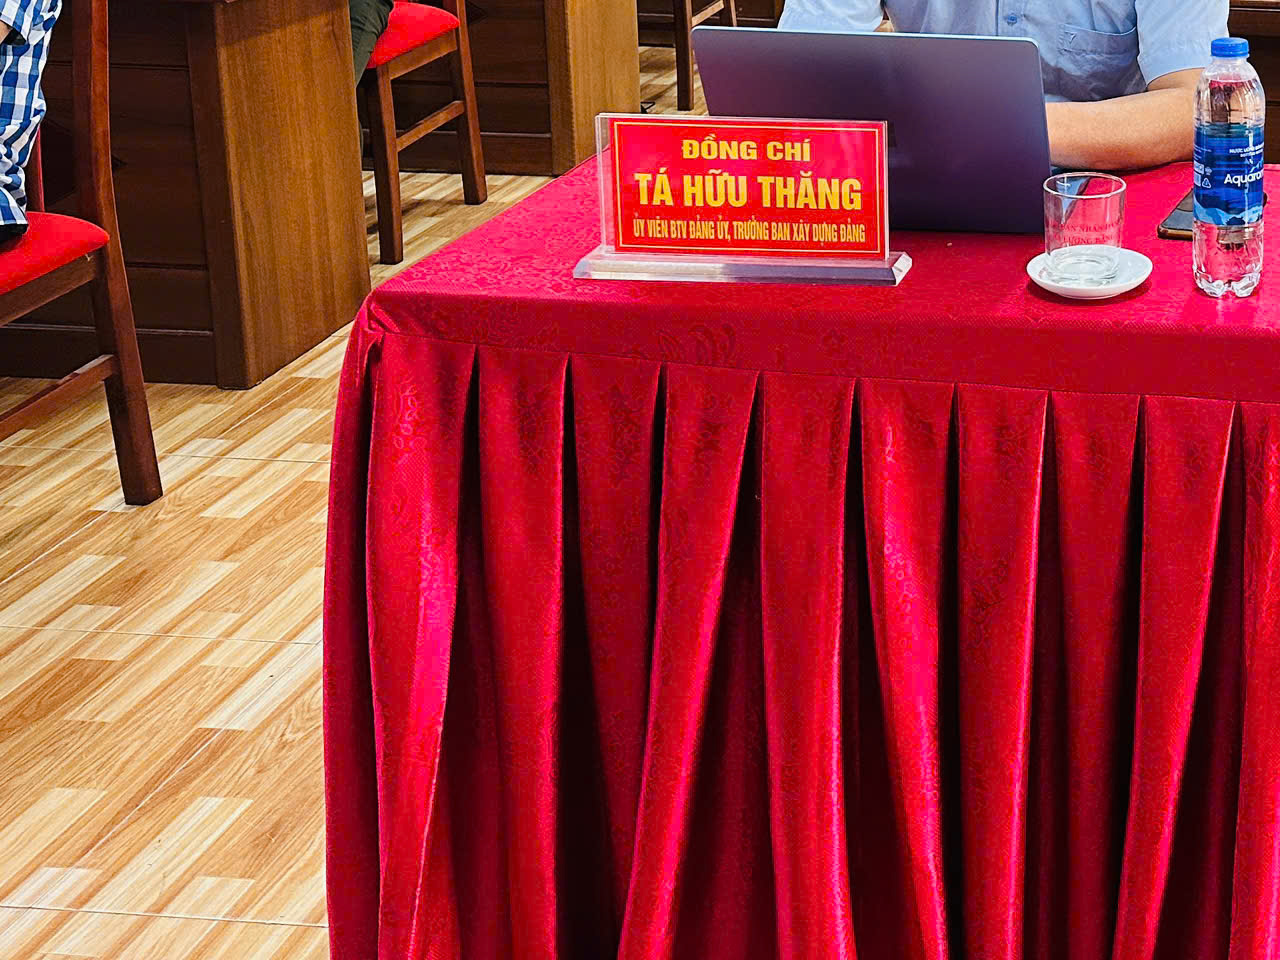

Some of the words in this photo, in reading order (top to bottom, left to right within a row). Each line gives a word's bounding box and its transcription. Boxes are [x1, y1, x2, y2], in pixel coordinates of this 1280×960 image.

[682, 133, 757, 160] ĐỒNG
[766, 138, 811, 161] CHÍ
[634, 167, 674, 206] TÁ
[683, 169, 747, 207] HỮU
[757, 170, 862, 210] THĂNG
[633, 212, 645, 238] ỦY
[648, 216, 668, 239] VIÊN
[670, 220, 687, 239] BTV
[689, 214, 714, 239] ĐẢNG
[733, 215, 769, 241] TRƯỞNG
[771, 222, 790, 241] BAN
[792, 219, 809, 242] XÂY
[812, 223, 837, 246] DỰNG
[839, 218, 866, 243] ĐẢNG
